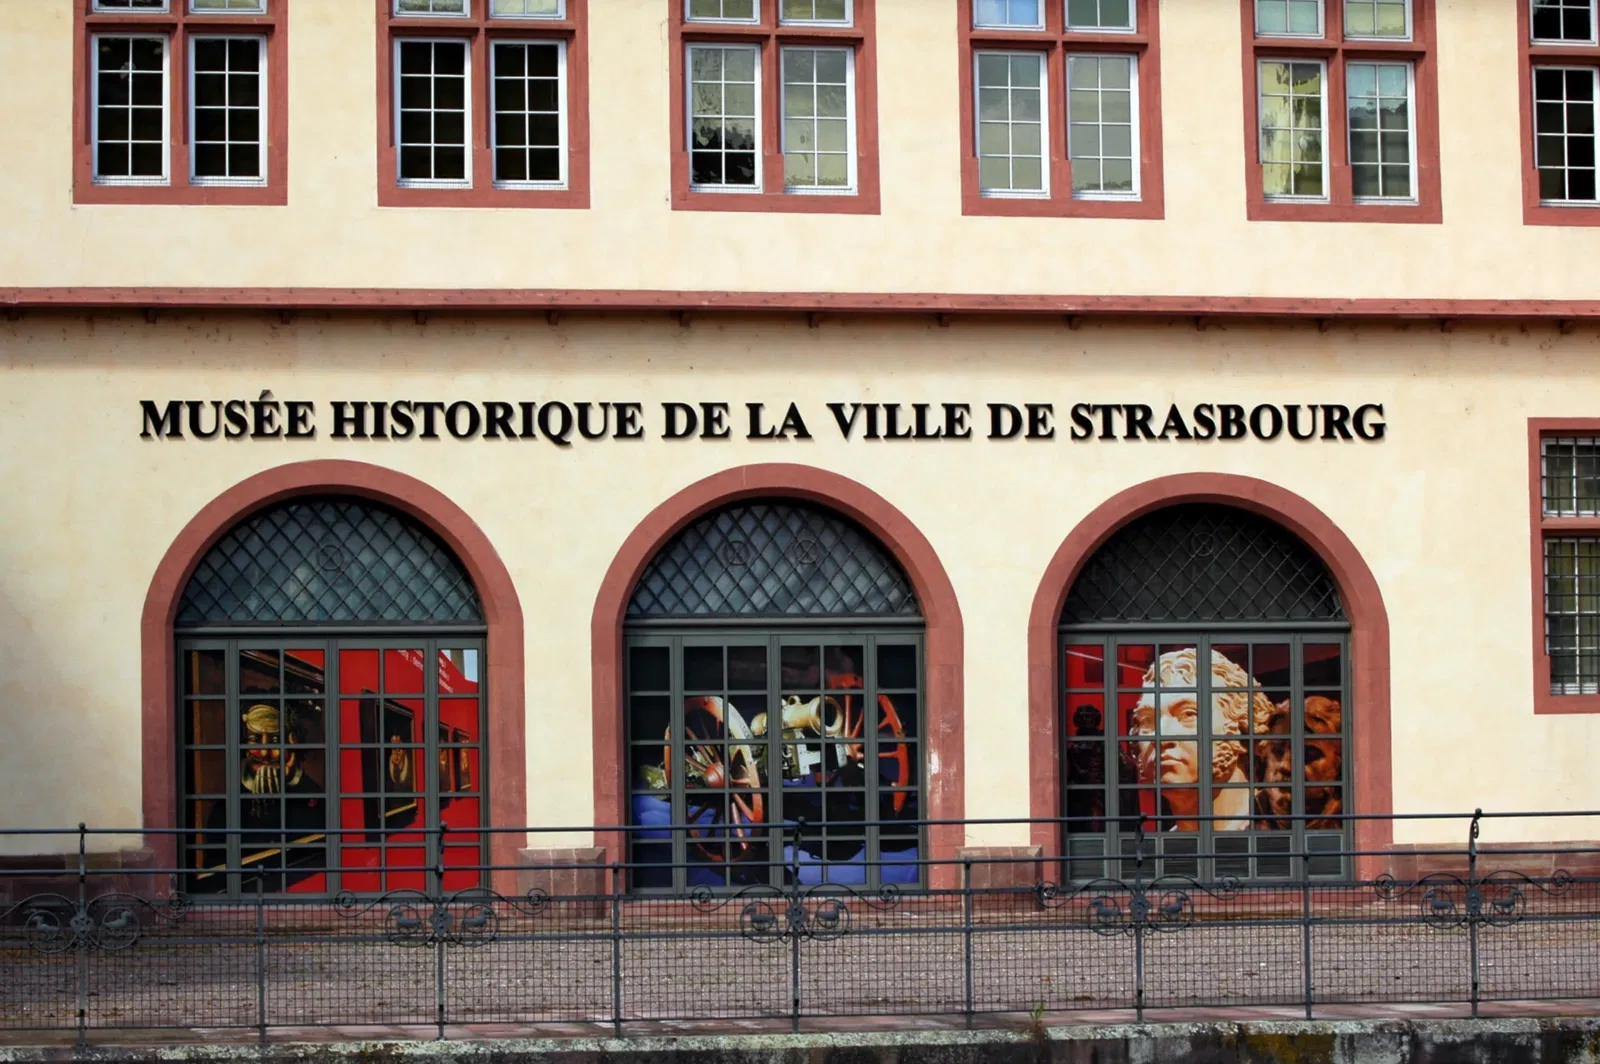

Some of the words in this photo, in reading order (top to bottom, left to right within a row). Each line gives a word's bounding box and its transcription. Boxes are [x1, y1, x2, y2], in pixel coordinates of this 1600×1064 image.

[140, 389, 315, 438] MUSÉE
[331, 400, 644, 446] HISTORIQUE
[661, 402, 731, 439] DE
[746, 402, 812, 439] LA
[827, 403, 972, 439] VILLE
[987, 403, 1055, 439] DE
[1070, 403, 1386, 441] STRASBOURG
